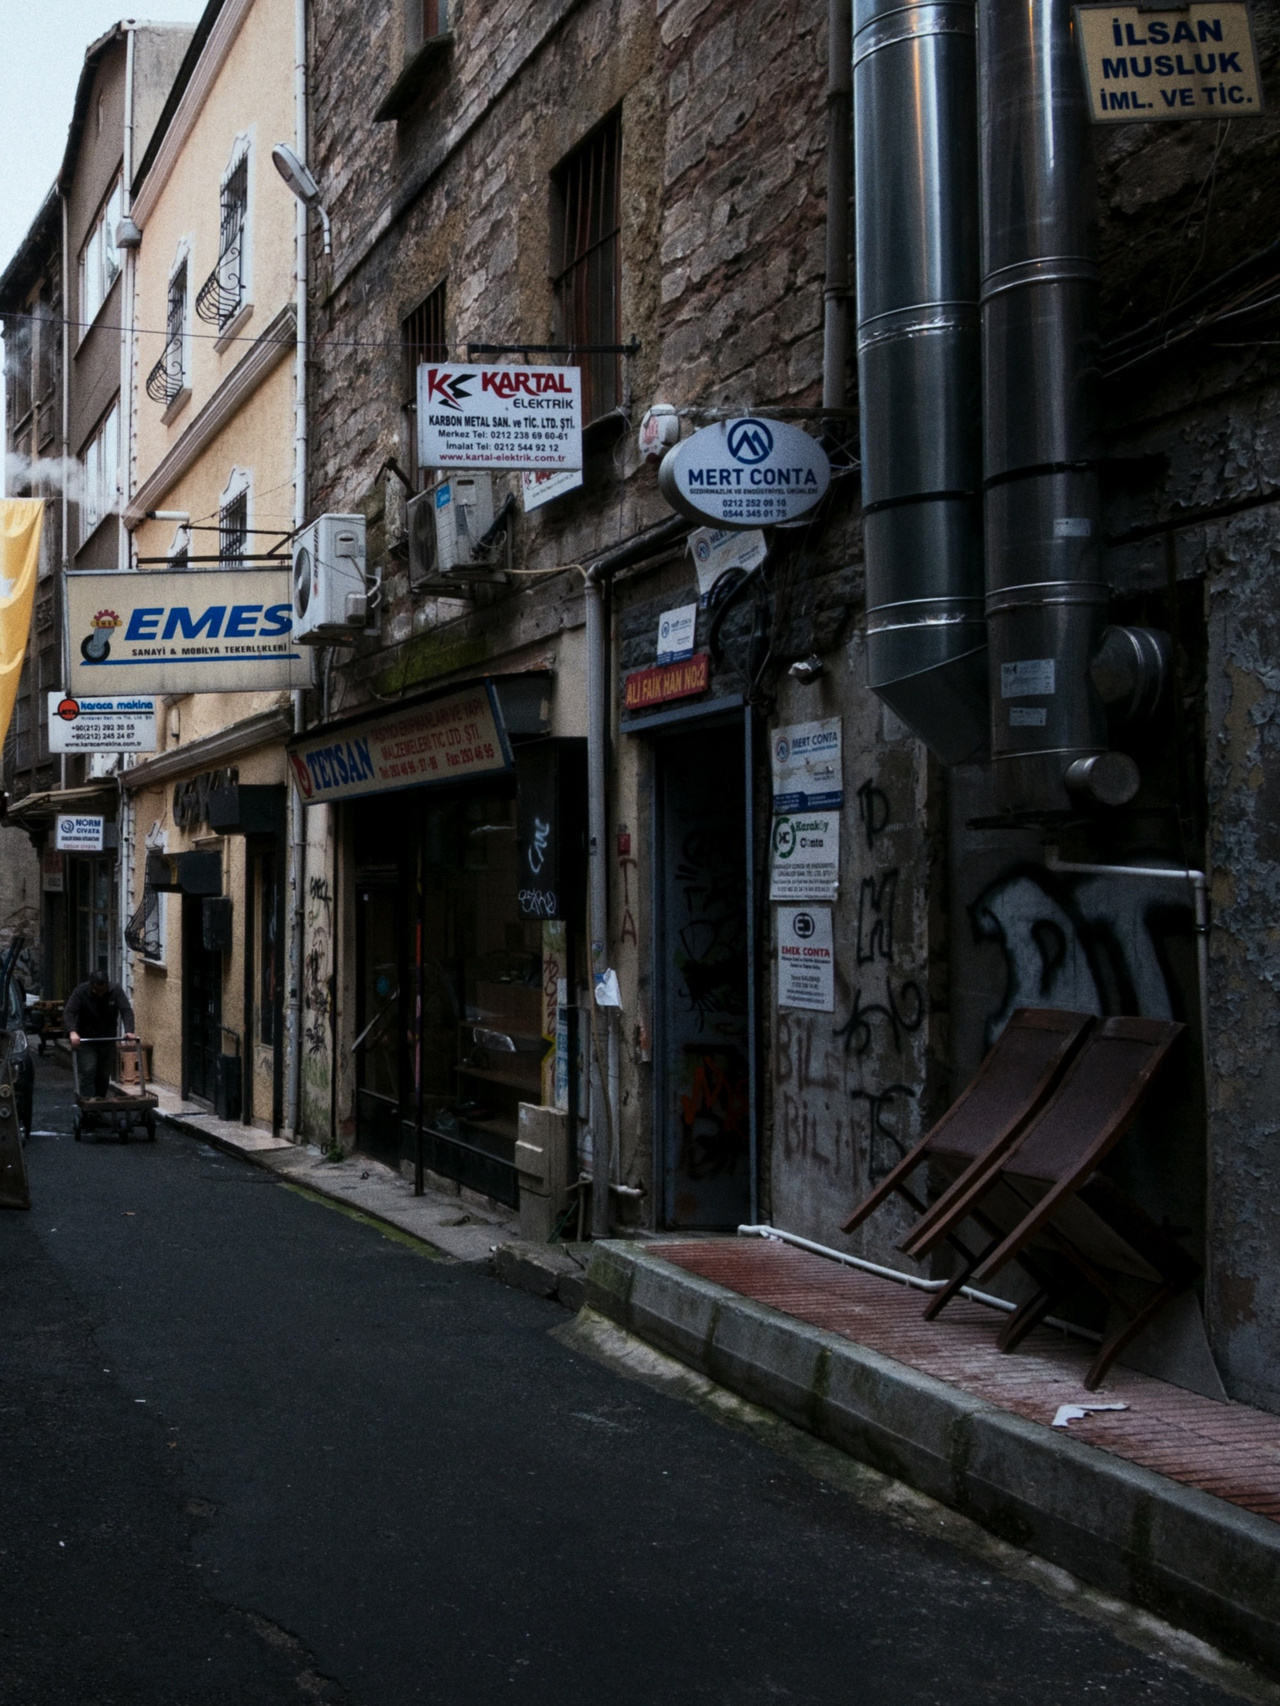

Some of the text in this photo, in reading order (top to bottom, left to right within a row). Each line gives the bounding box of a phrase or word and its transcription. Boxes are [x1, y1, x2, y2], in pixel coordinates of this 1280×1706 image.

[1112, 18, 1223, 46] İLSAN
[1102, 52, 1242, 79] MUSLUK
[1100, 82, 1253, 111] İML. VE TİC.
[482, 372, 572, 398] KARTAL
[513, 397, 573, 409] ELEKTRİK
[429, 415, 575, 431] KARBON METAL SAN. ve TİC. LTD. ŞTİ.
[438, 430, 568, 440] Merkez Tel: 0212 238 69 60-61
[446, 441, 559, 452] İmalat Tel: 0212 544 92 12
[439, 453, 566, 462] www.kartal-elektrik.com.tr
[688, 468, 817, 485] MERT CONTA
[722, 499, 743, 507] 0212
[745, 499, 761, 507] 252
[777, 499, 787, 507] 10
[124, 604, 293, 641] EMES
[132, 646, 166, 656] SANAYİ
[182, 645, 220, 656] MOBİLYA
[224, 643, 287, 654] TEKERLEKLERİ
[626, 676, 640, 706] ALİ
[663, 669, 682, 696] HAN
[81, 700, 153, 710] karaca makina
[446, 727, 464, 746] LTD.
[792, 731, 838, 749] MERT CONTA
[306, 737, 375, 790] TETSAN
[76, 819, 101, 828] NORM
[781, 946, 830, 957] EMEK CONTA
